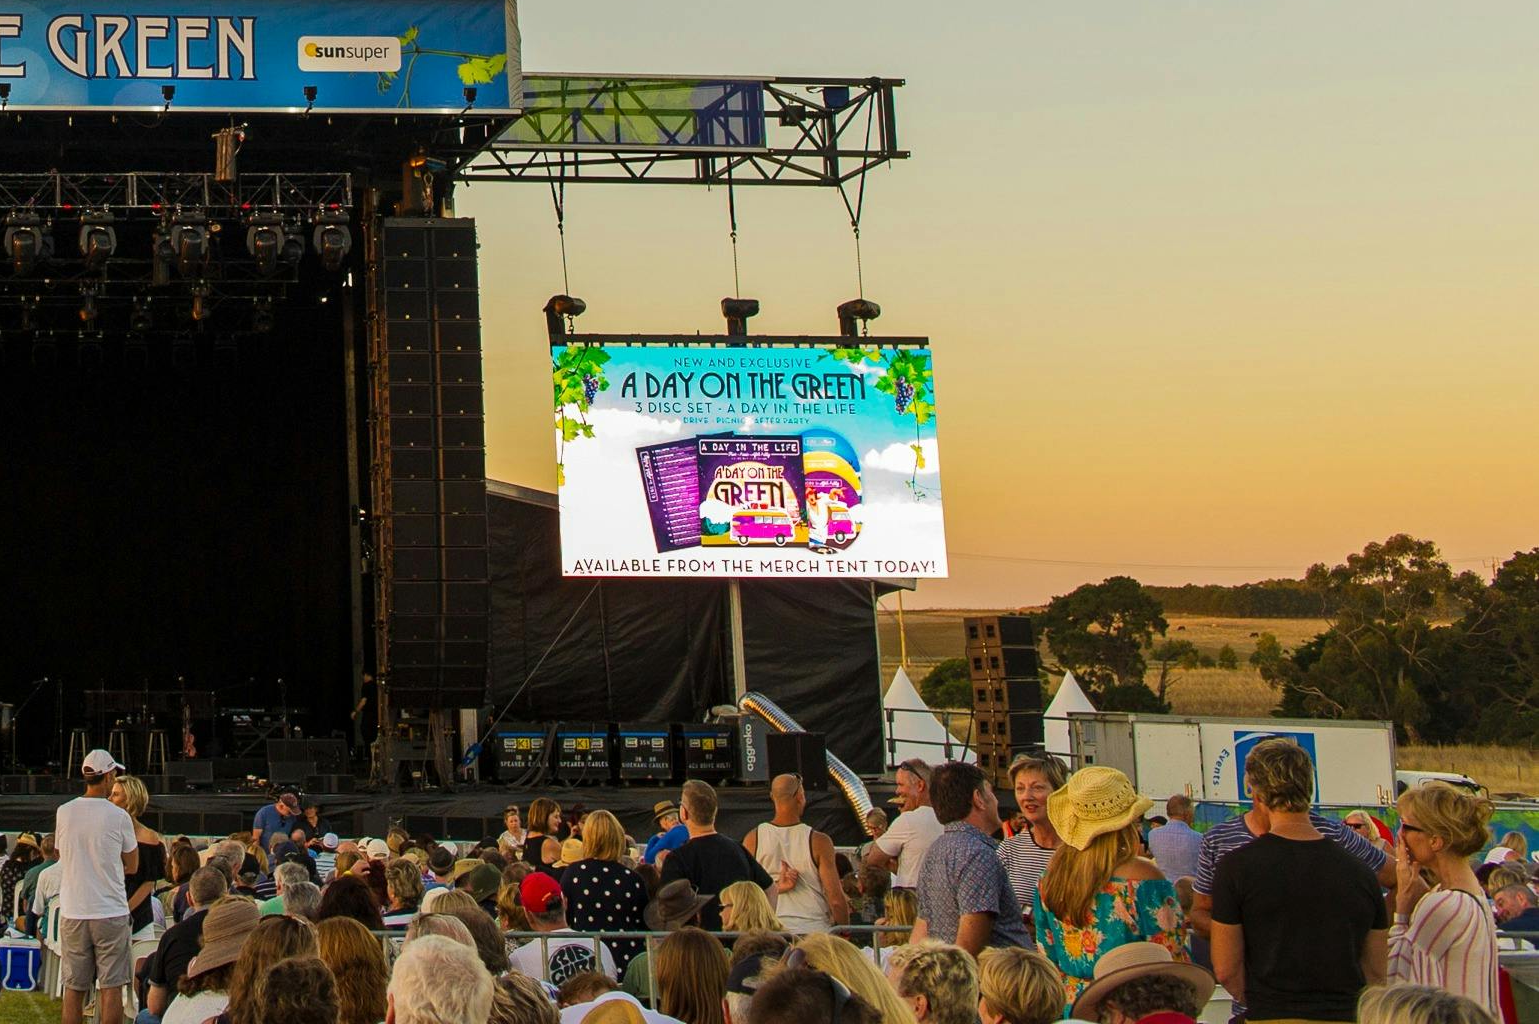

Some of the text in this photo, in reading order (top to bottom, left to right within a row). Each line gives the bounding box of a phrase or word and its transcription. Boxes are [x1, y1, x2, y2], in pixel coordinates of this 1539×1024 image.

[45, 13, 258, 81] GREEN
[313, 42, 390, 63] sunsuper
[674, 357, 811, 369] NEW AND EXCLUSIVE
[621, 371, 866, 400] A DAY ON THE GREEN
[635, 401, 857, 415] 3 DISC SET A DAY IN THE LIFE
[701, 442, 797, 453] A DAY IN THE LIFE
[747, 466, 764, 479] ON
[767, 466, 784, 479] THE
[713, 480, 786, 508] GREEN
[572, 559, 936, 574] AVAILABLE FROM THE MERCH TENT TODAY!
[743, 723, 757, 772] aggreko
[1212, 748, 1231, 786] Events
